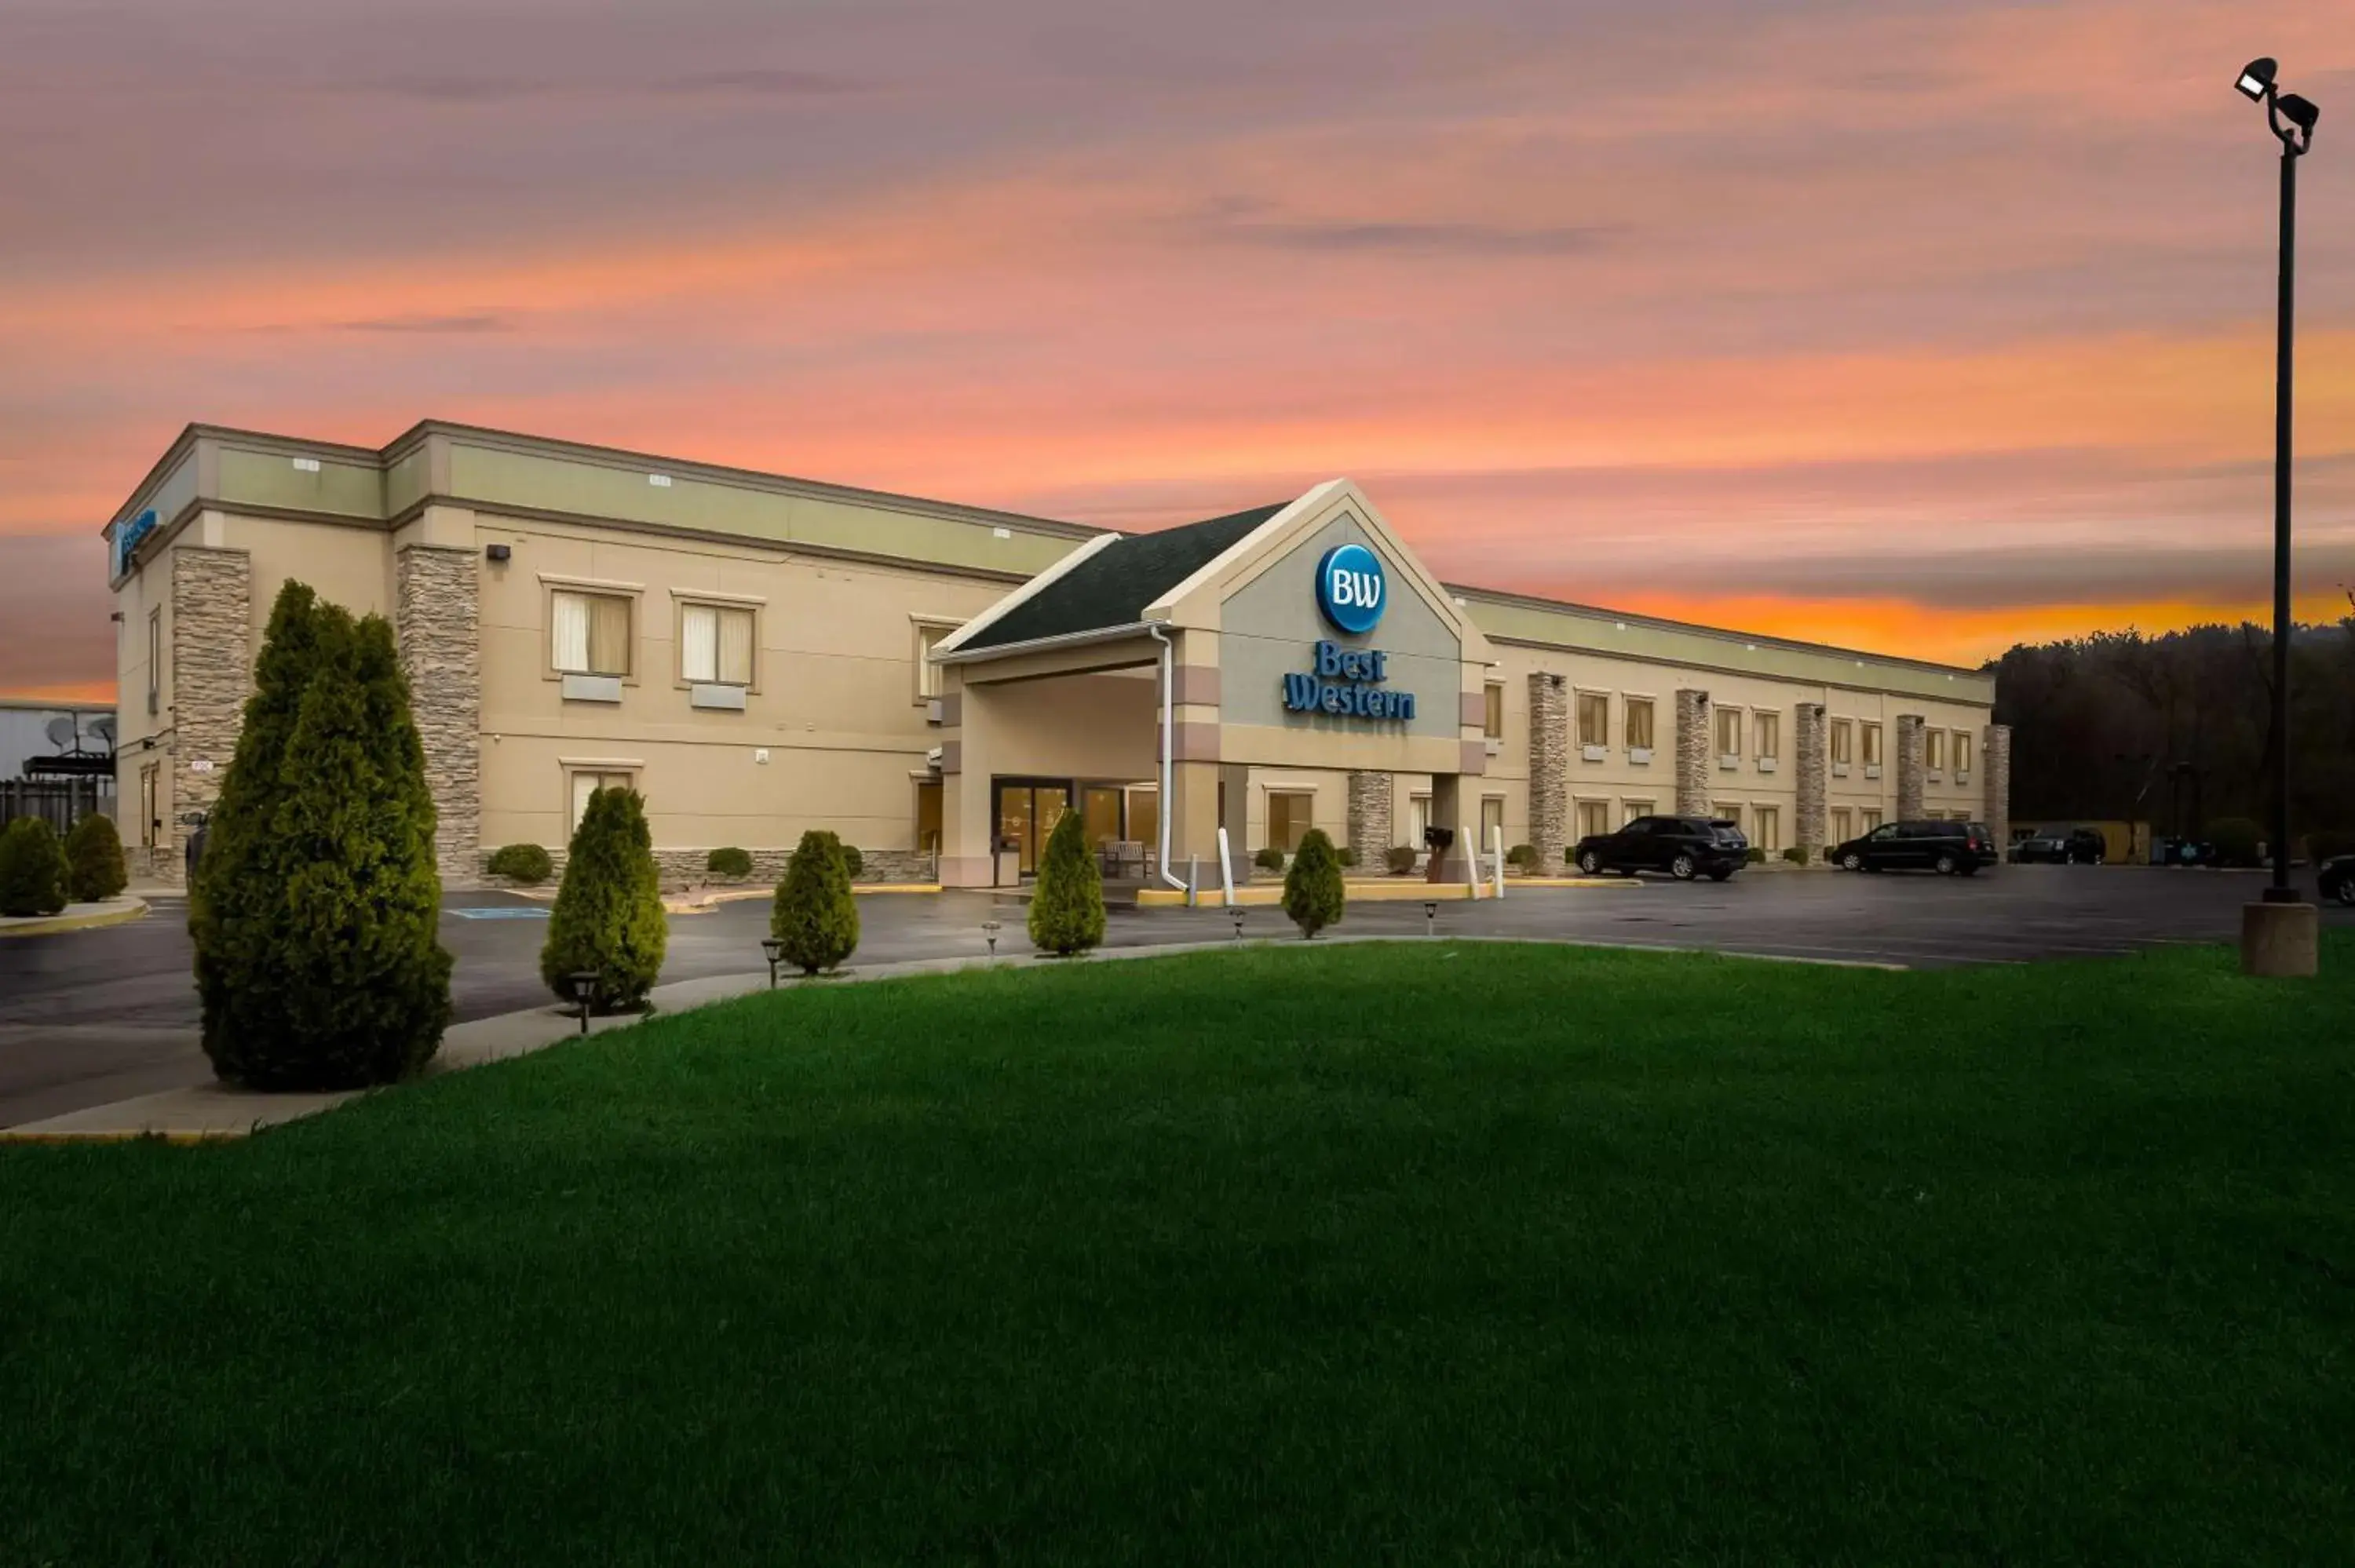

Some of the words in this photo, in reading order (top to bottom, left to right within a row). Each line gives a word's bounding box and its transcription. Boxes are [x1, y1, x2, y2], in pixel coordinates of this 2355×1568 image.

[1334, 569, 1380, 607] BW
[1316, 640, 1387, 682] Best
[1284, 673, 1415, 720] Western
